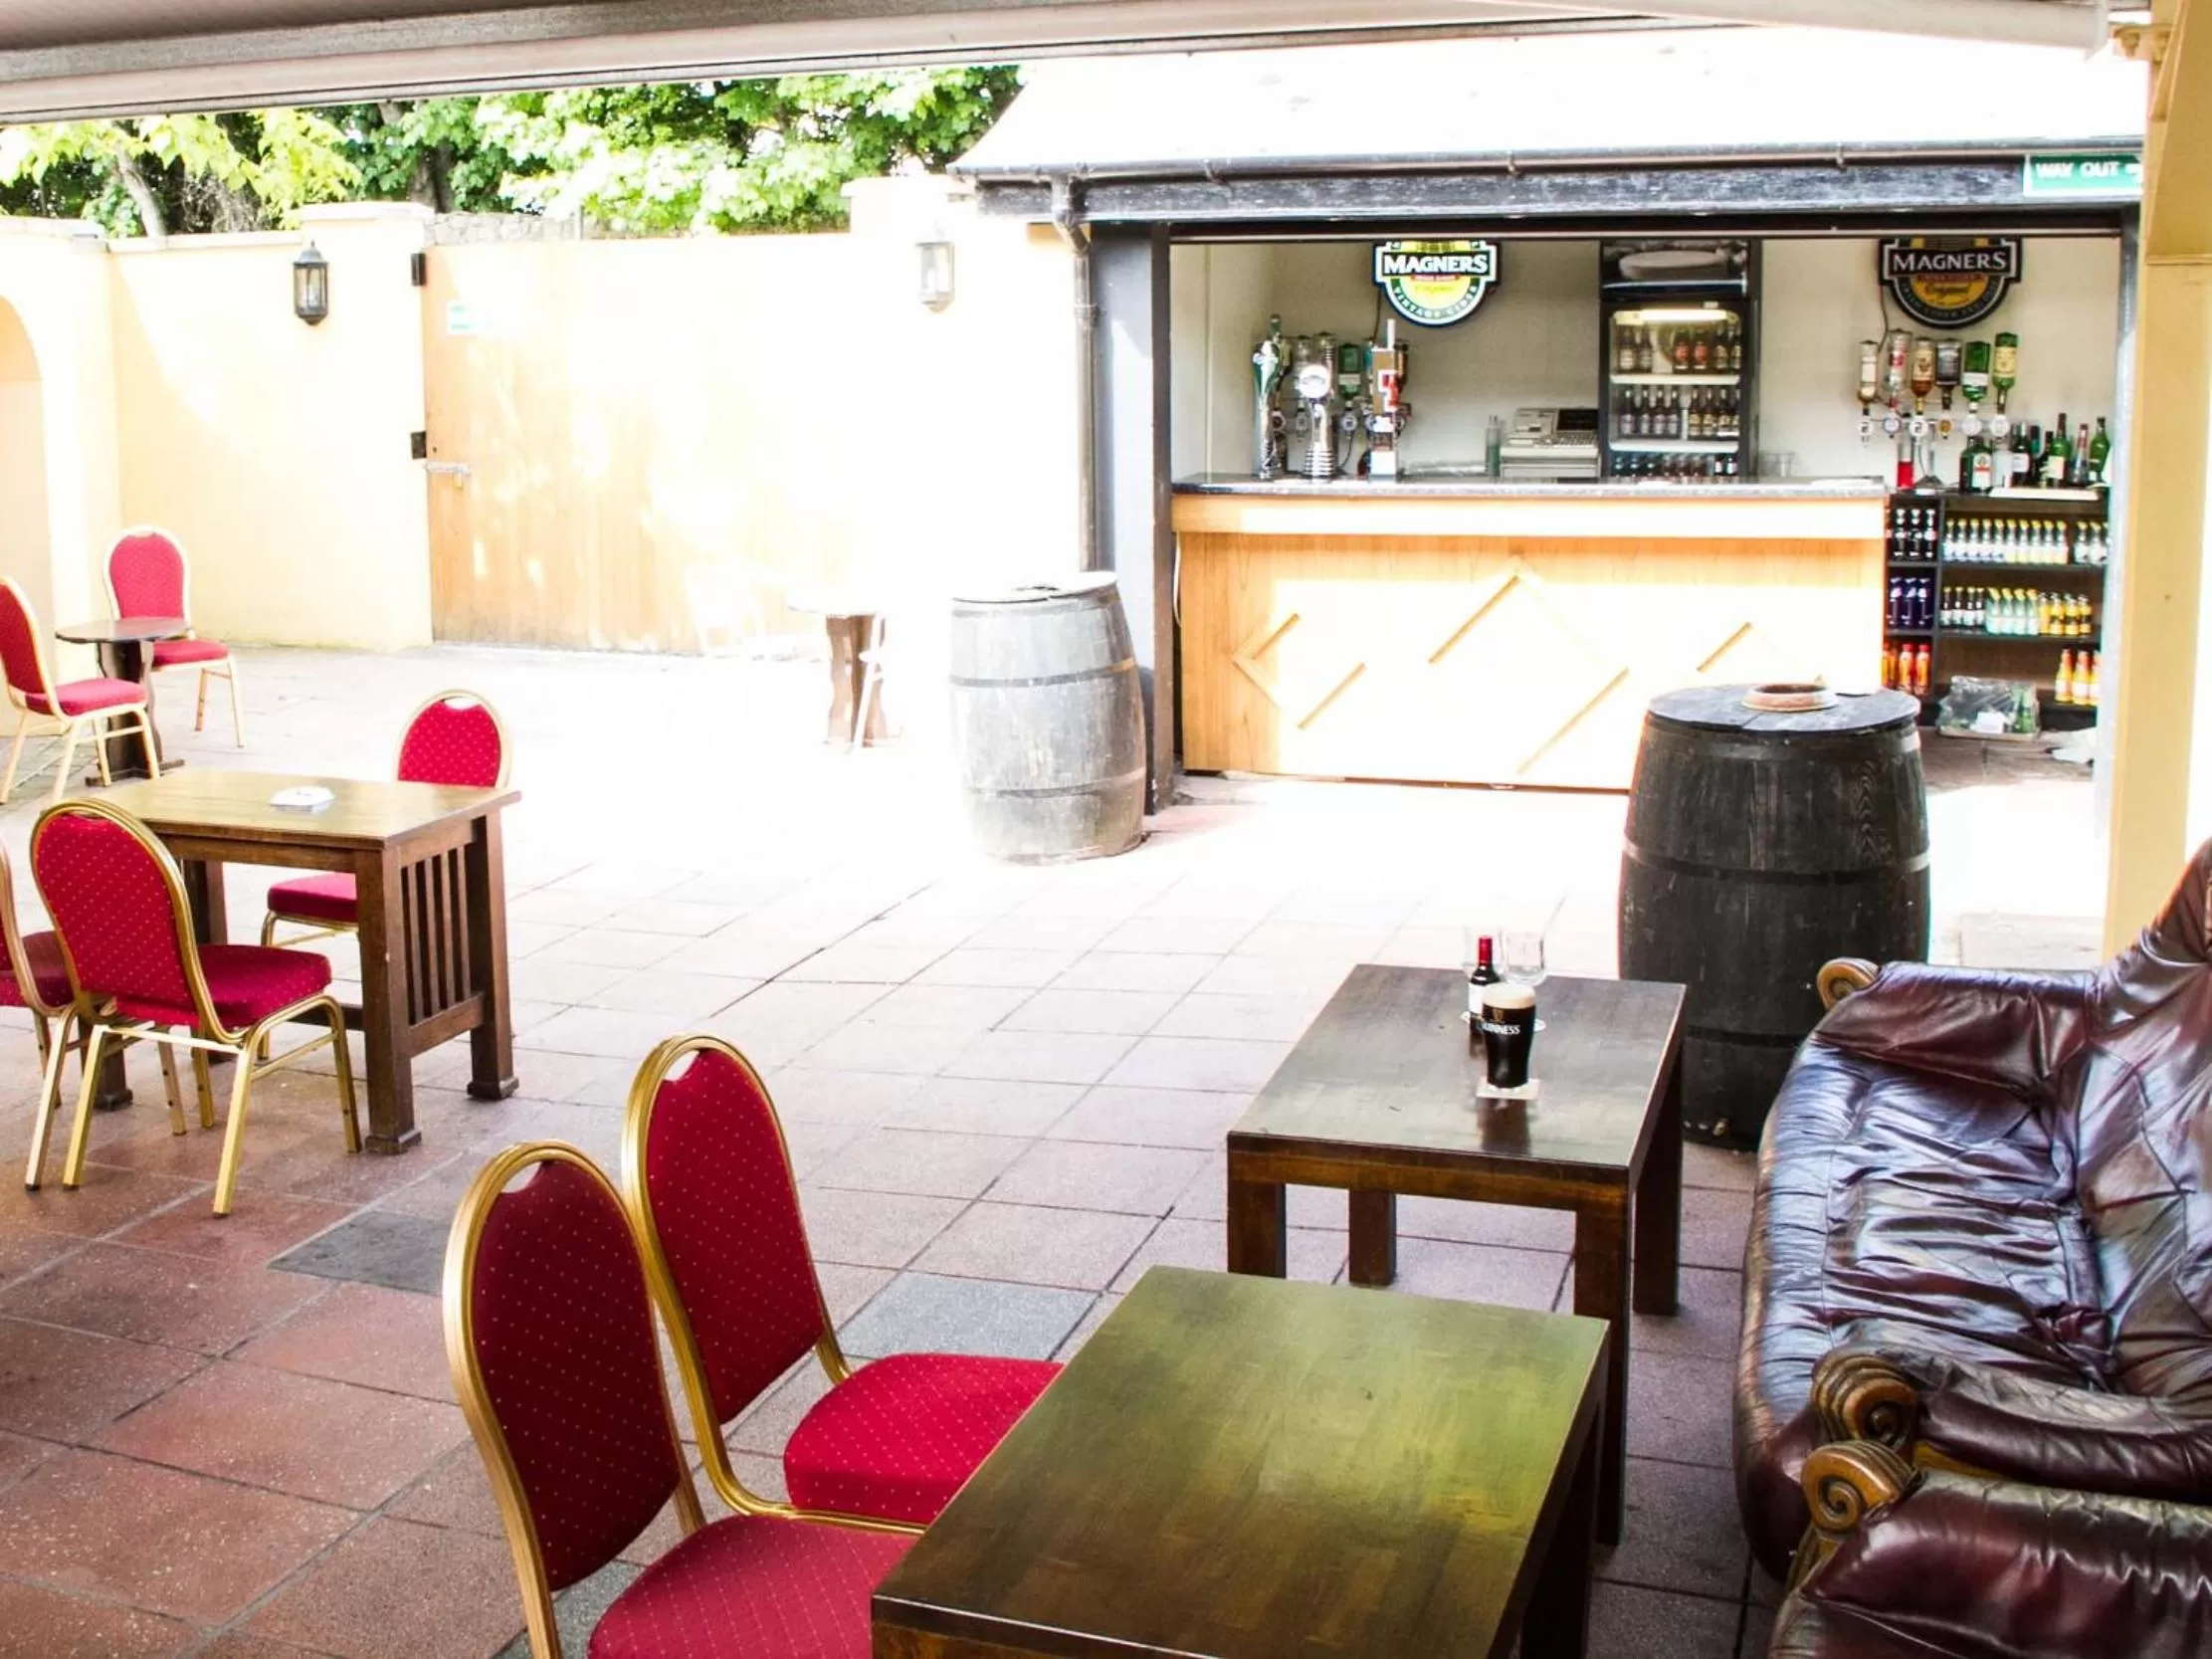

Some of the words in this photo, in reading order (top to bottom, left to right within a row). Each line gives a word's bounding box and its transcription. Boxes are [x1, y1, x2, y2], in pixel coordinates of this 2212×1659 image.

[2037, 163, 2074, 178] WAY
[2081, 161, 2119, 177] OUT
[1383, 254, 1489, 274] MAGNERS
[1893, 251, 2007, 271] MAGNERS
